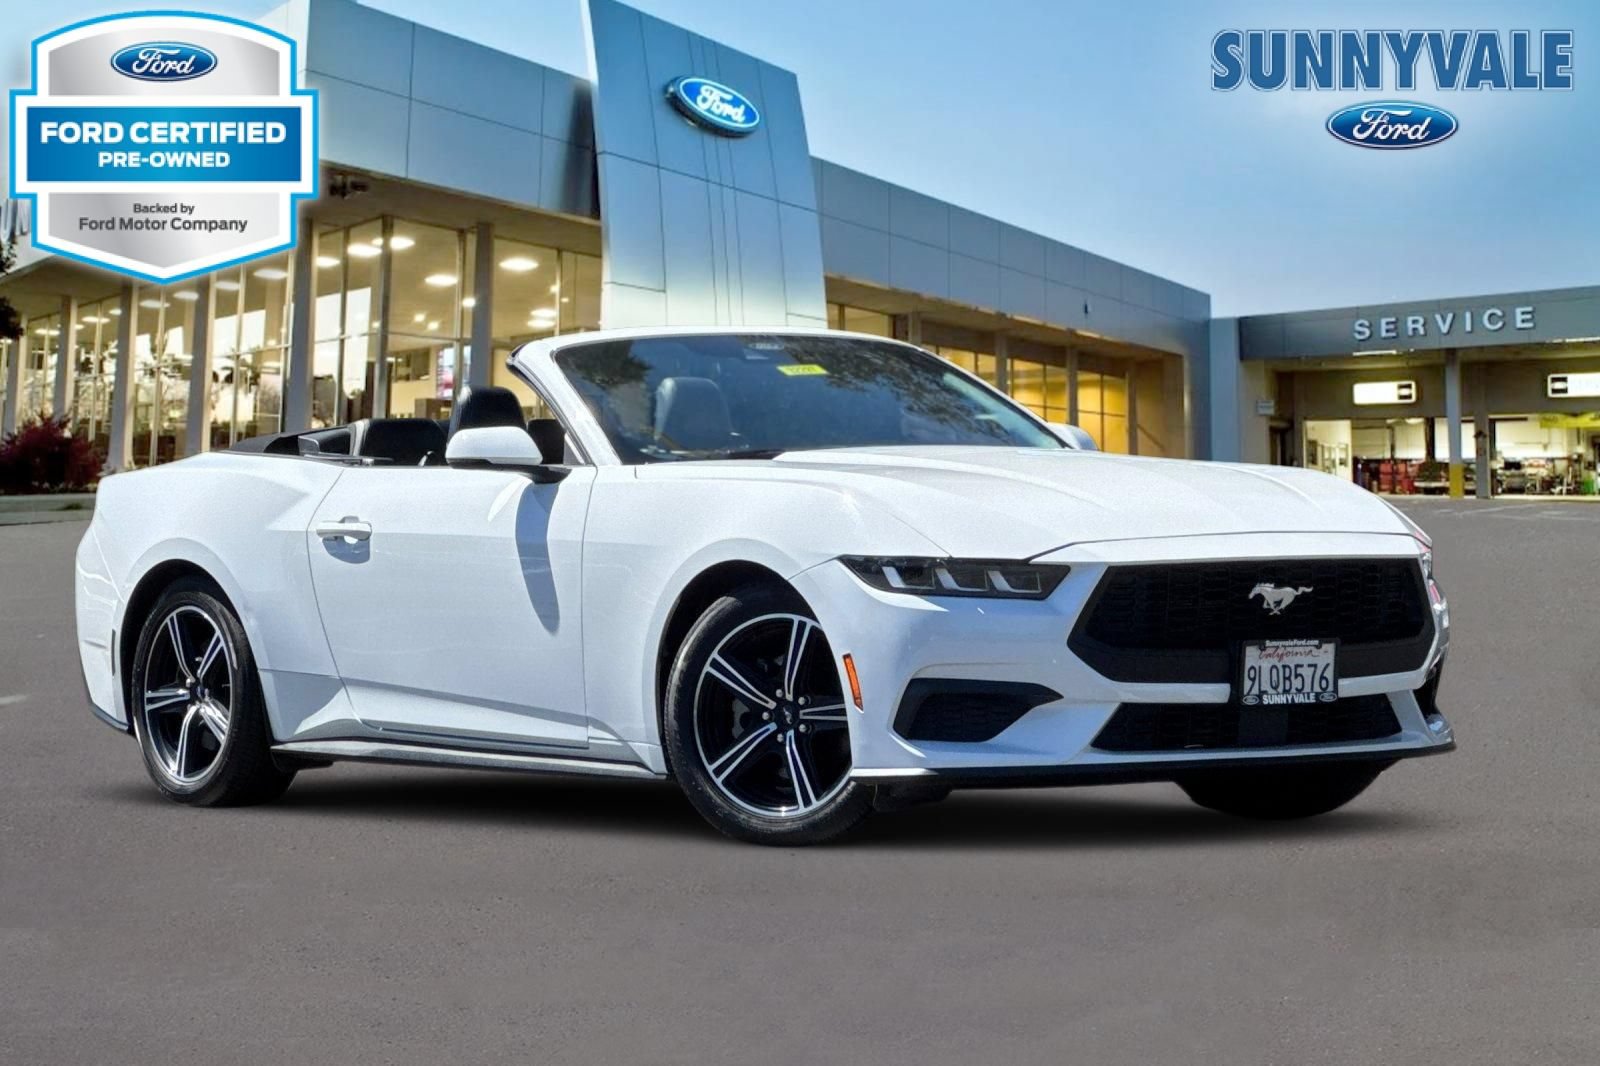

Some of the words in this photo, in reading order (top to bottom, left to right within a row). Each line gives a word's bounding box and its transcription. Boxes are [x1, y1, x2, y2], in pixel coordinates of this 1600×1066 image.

[696, 85, 746, 122] Ford
[1353, 306, 1535, 341] SERVICE
[1247, 663, 1330, 695] 9LQB576
[1262, 692, 1317, 704] SUNNYVALE
